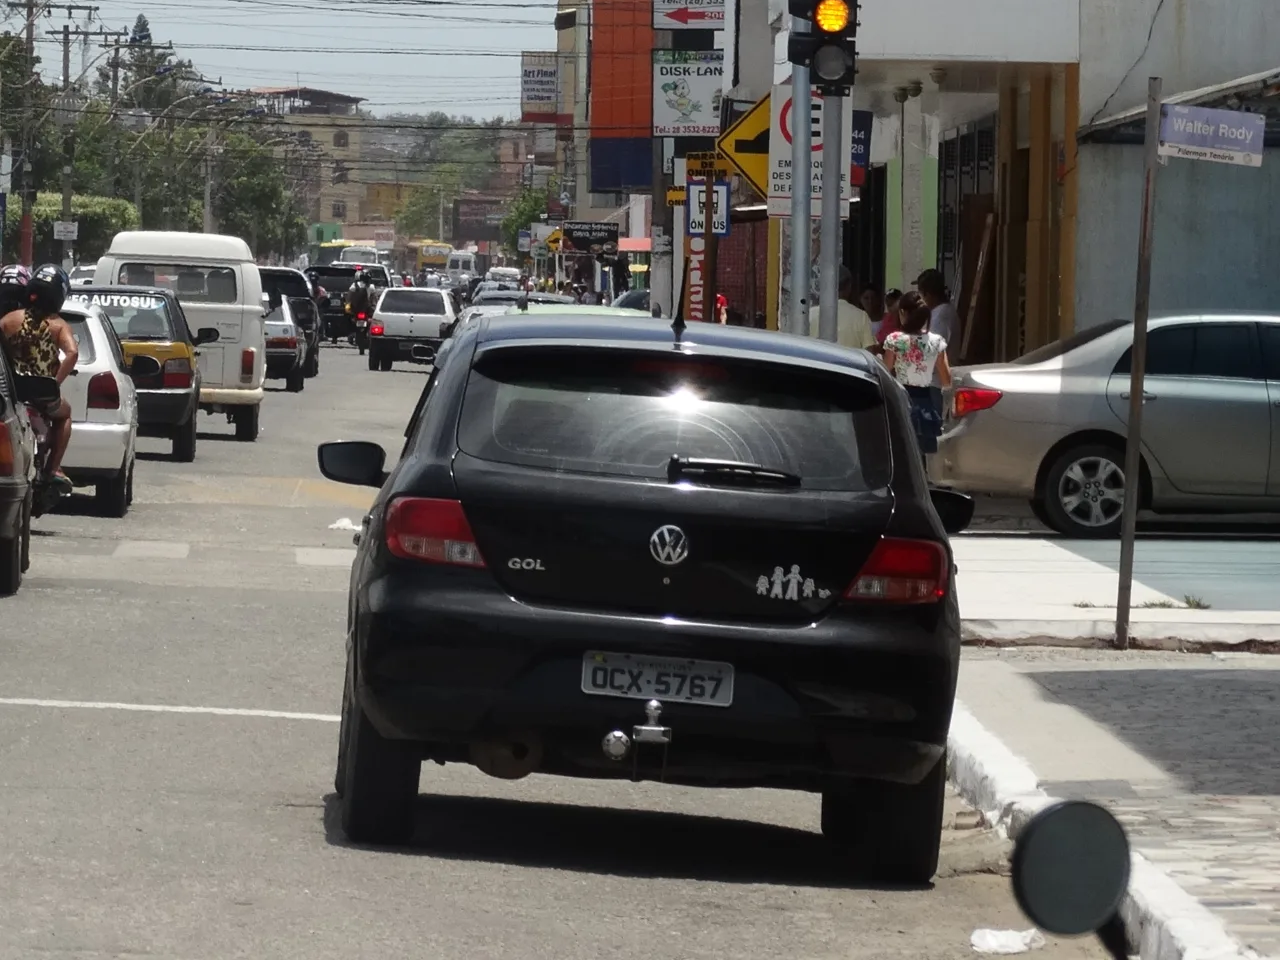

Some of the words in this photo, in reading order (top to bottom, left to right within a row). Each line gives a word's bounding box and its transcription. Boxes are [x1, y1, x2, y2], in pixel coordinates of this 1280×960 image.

[660, 66, 723, 77] DISK-LAN
[1173, 117, 1215, 136] Walter
[1219, 123, 1254, 144] Rody
[700, 161, 715, 169] DE
[773, 184, 786, 192] DE
[691, 220, 726, 230] ÔNUS
[91, 294, 158, 309] AUTOSUL
[507, 557, 546, 571] GOL
